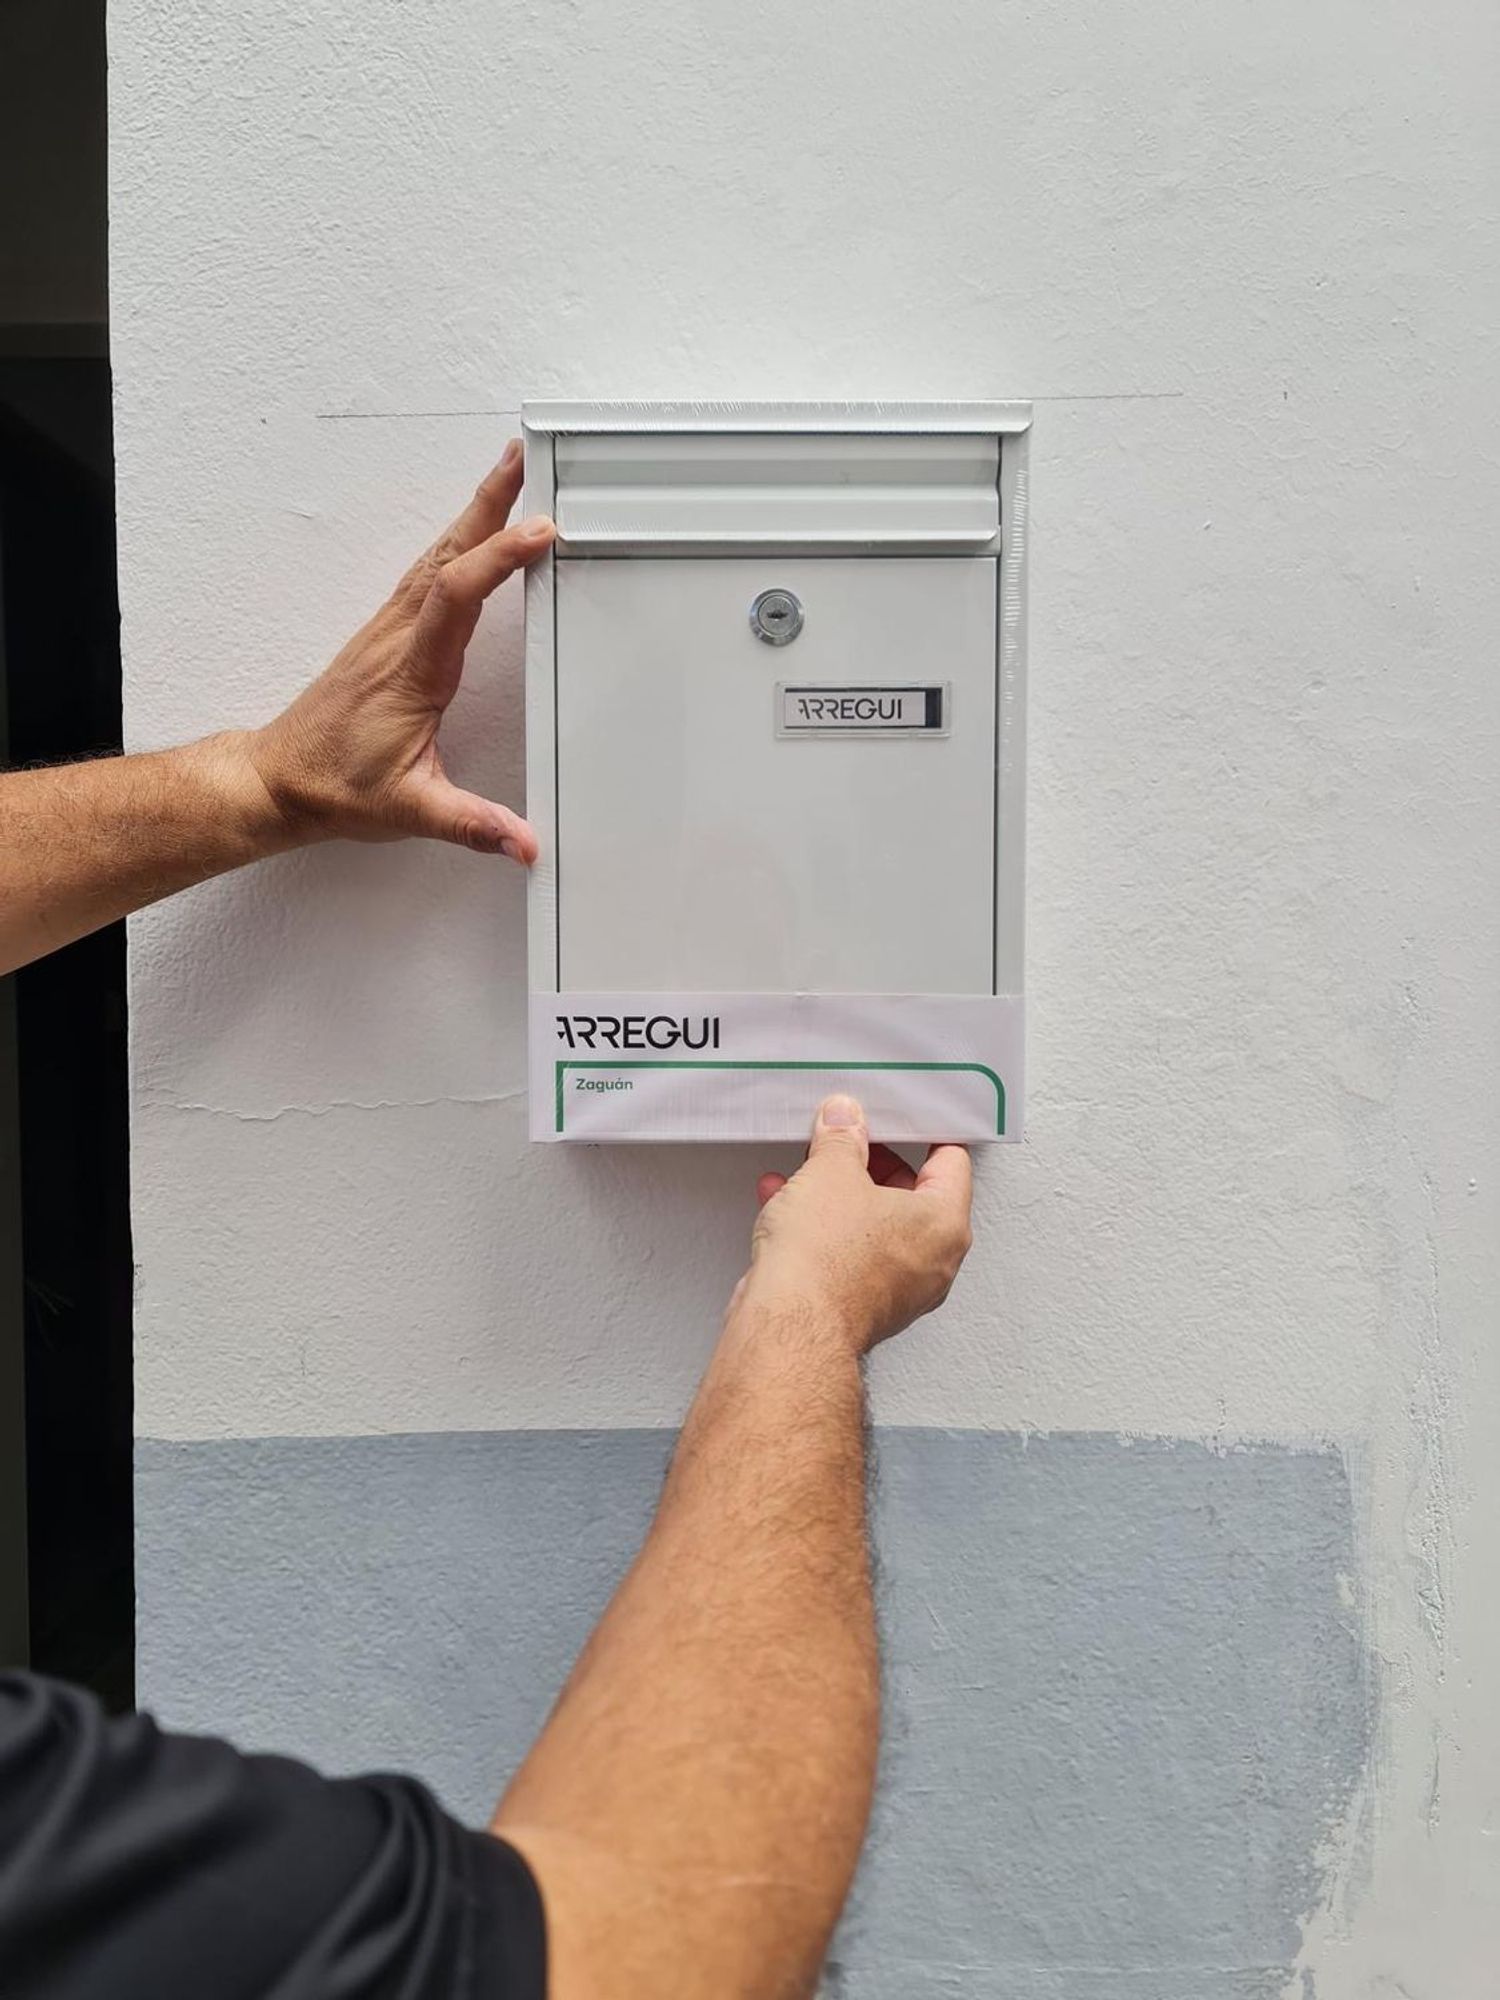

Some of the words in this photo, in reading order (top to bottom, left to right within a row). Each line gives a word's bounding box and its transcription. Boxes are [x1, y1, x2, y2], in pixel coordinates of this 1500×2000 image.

[798, 698, 902, 720] ARREGUI
[555, 1015, 719, 1049] ARREGUI
[575, 1077, 633, 1093] Zaguán
